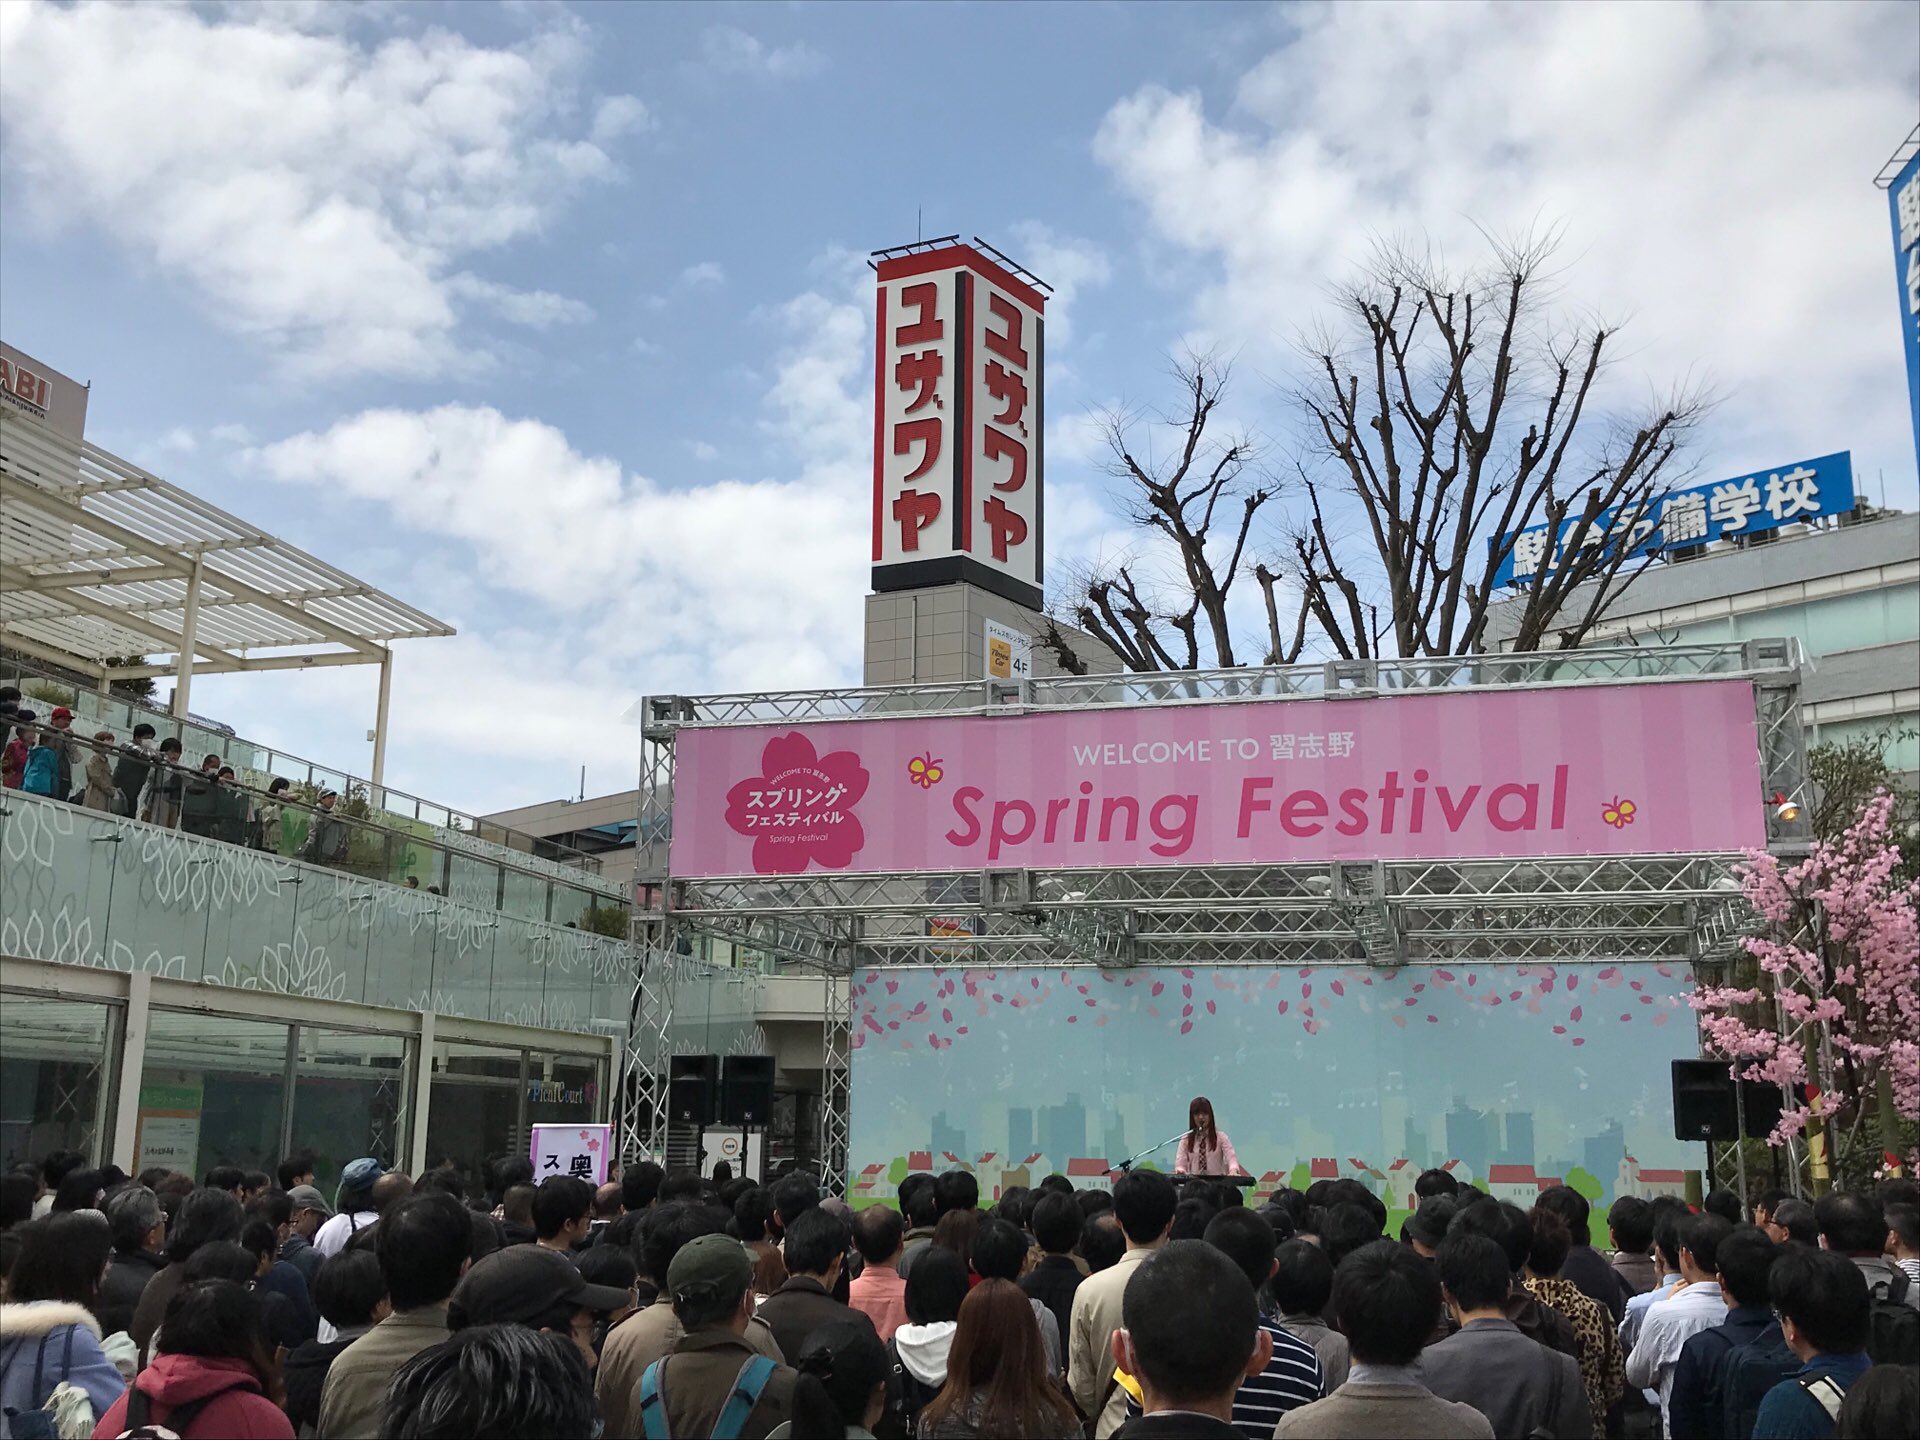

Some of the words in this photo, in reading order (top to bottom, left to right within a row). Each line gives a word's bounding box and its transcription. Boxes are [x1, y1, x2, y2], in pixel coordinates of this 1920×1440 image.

[893, 281, 943, 552] ユザワヤ
[983, 291, 1028, 563] ユザワヤ
[1013, 658, 1028, 674] 4F
[1073, 741, 1211, 766] WELCOME
[1221, 738, 1260, 761] TO
[1270, 731, 1355, 760] 習志野
[770, 768, 801, 785] WELCOME
[747, 783, 848, 809] スプリング
[746, 811, 844, 828] フェスティバル
[945, 781, 1199, 860] Spring
[1237, 764, 1569, 839] Festival
[769, 834, 796, 844] Spring
[797, 833, 828, 842] Festival
